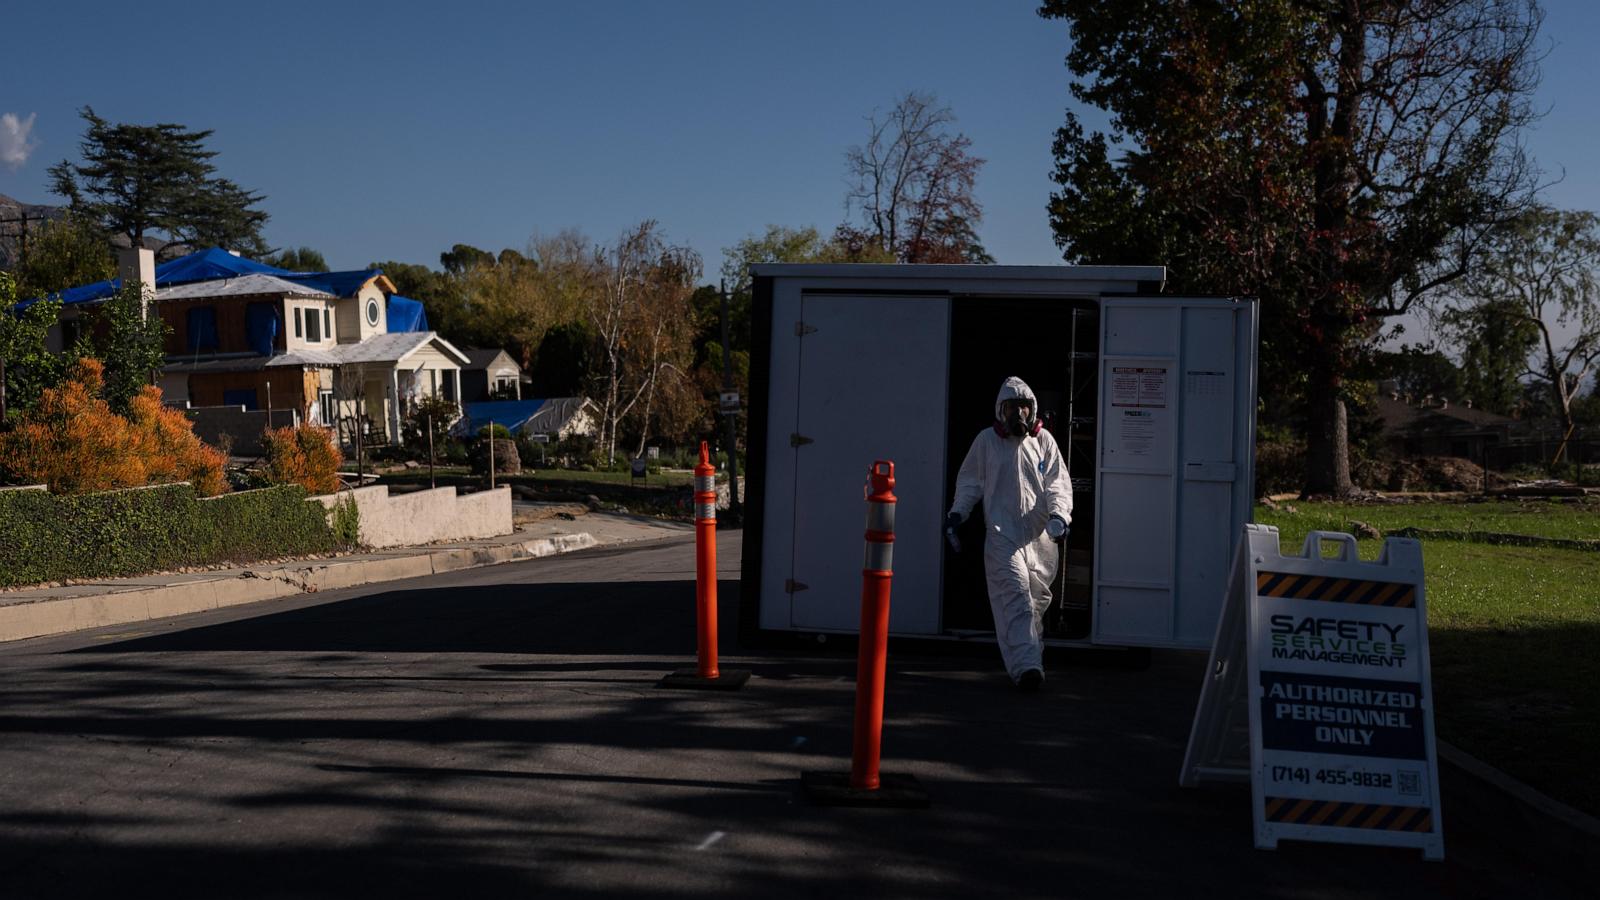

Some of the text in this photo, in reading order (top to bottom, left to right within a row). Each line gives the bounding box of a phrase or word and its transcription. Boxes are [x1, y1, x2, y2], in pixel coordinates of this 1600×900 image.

[1270, 614, 1405, 643] SAFETY
[1272, 634, 1406, 656] SERVICES
[1272, 647, 1407, 668] MANAGEMENT
[1268, 682, 1416, 709] AUTHORIZED
[1275, 703, 1412, 729] PERSONNEL
[1315, 725, 1375, 746] ONLY
[1272, 765, 1393, 788] (714) 455-9832
